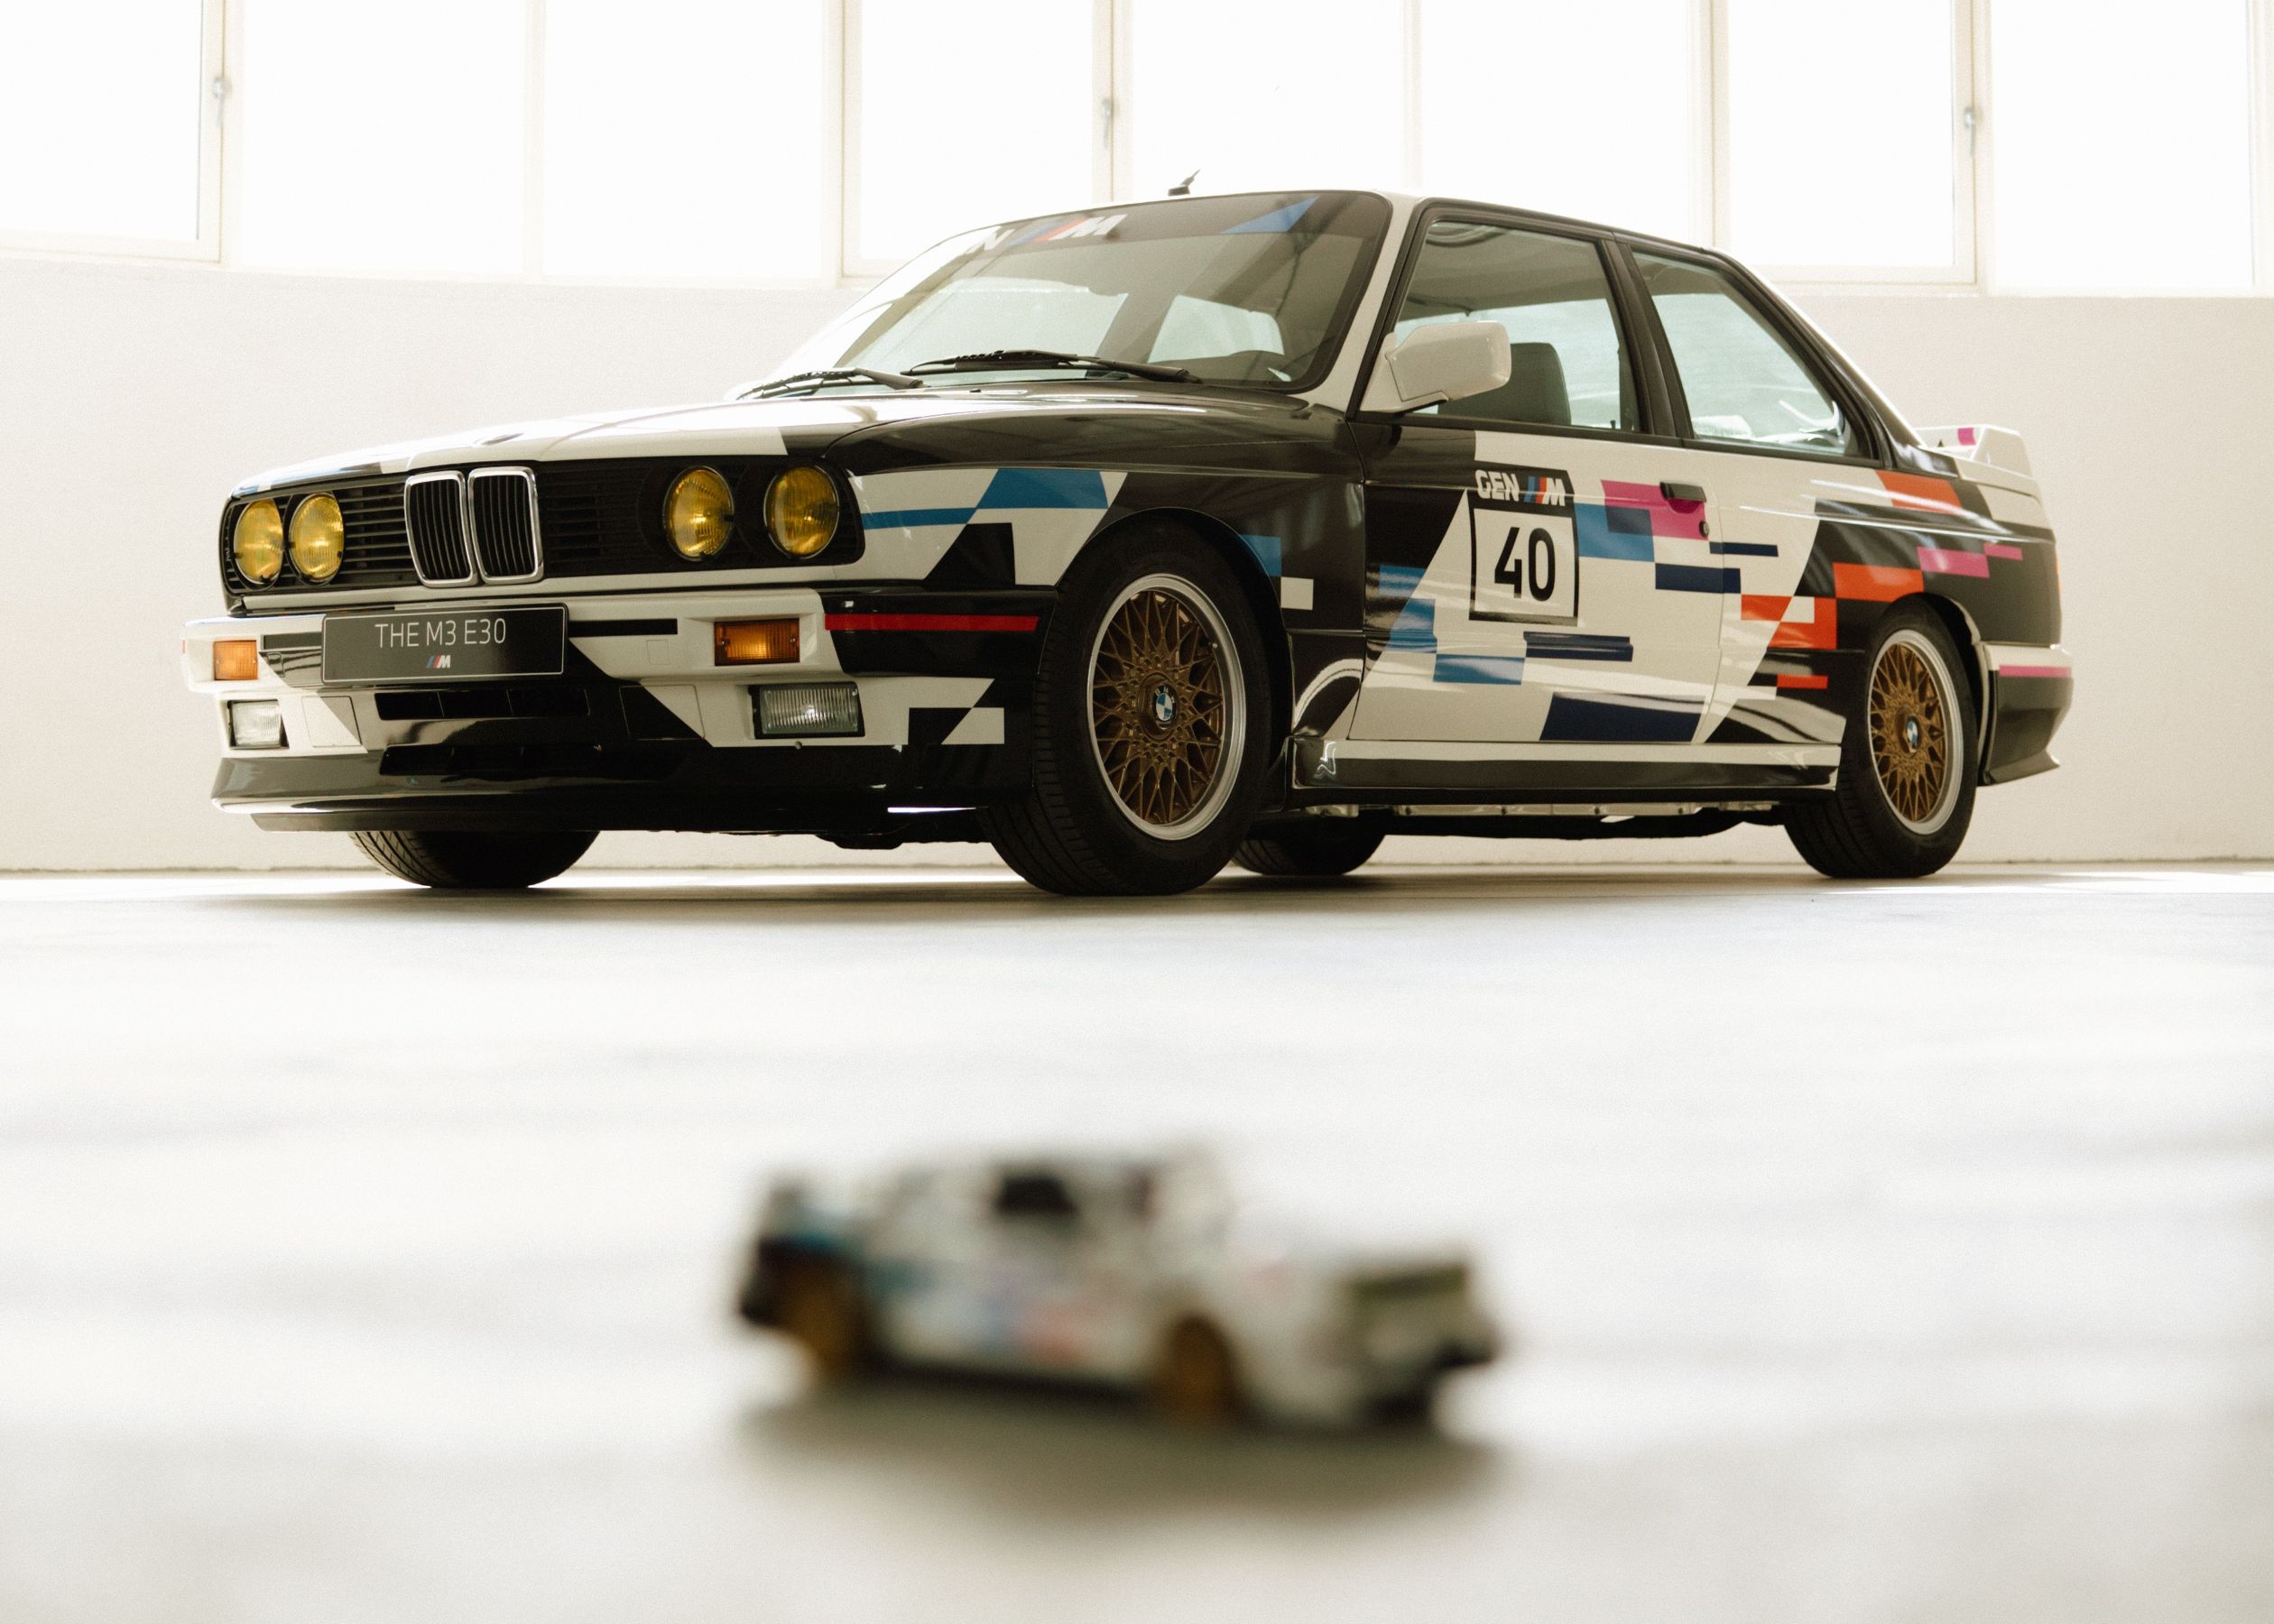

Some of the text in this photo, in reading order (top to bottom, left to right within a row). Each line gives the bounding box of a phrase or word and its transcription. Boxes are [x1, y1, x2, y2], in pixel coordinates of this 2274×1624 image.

[1474, 469, 1520, 502] GEN
[1494, 526, 1556, 602] 40
[374, 617, 506, 648] THE M3 E30
